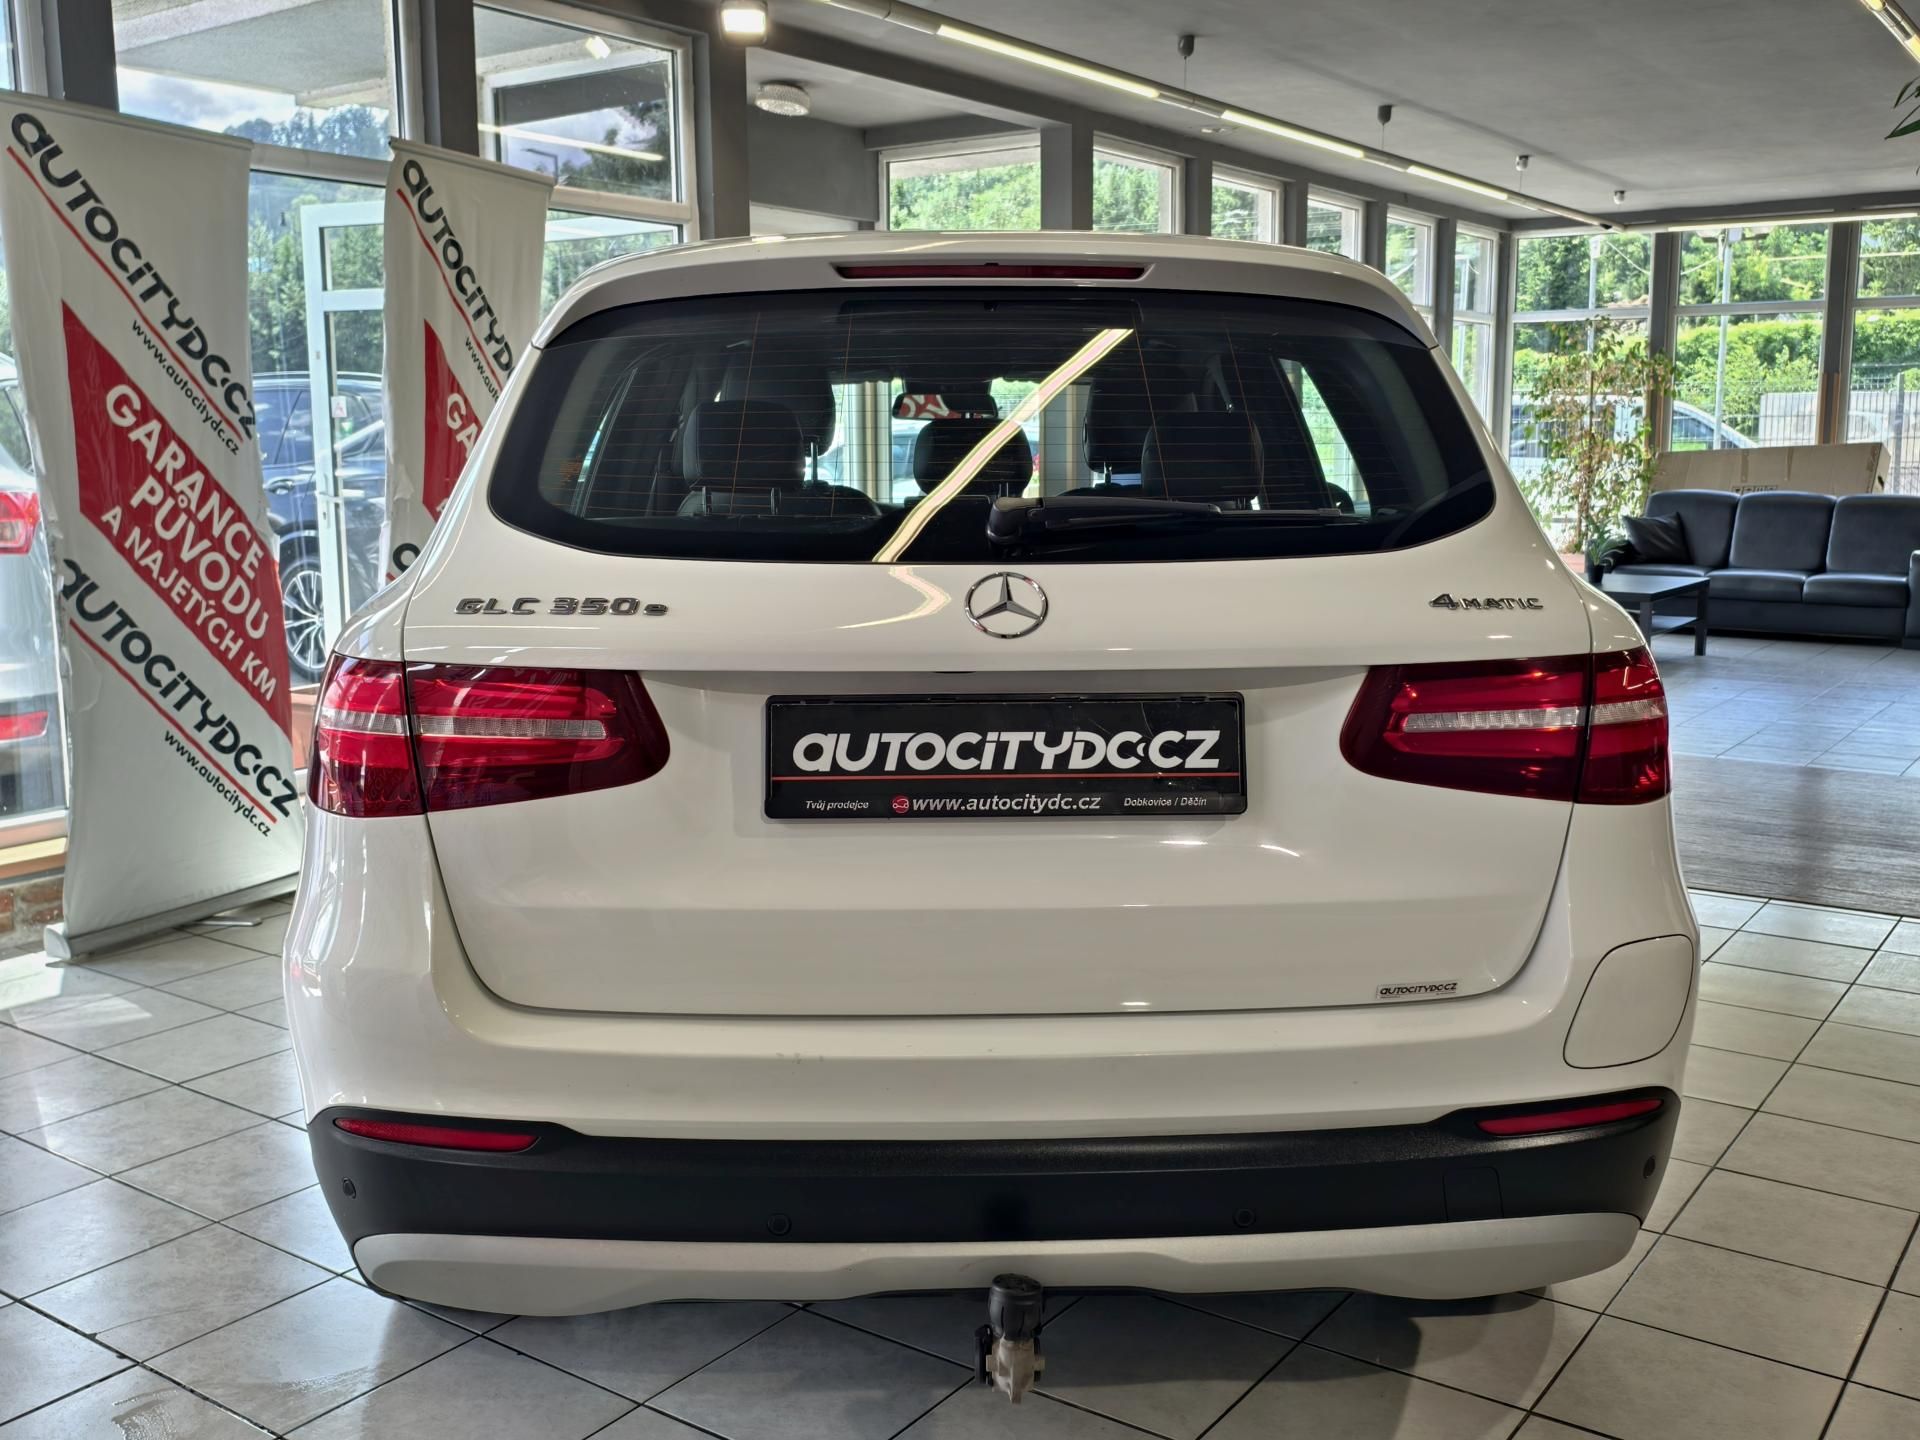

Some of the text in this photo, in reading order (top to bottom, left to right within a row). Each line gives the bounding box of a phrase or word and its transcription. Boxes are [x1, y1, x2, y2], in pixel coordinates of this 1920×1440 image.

[132, 319, 239, 456] www.autocitydc.cz
[106, 384, 264, 579] GARANCE
[101, 505, 277, 701] A NAJETÝCH KM
[130, 474, 269, 640] PŮVODU
[454, 597, 541, 615] GLC
[1428, 593, 1544, 610] 4MATIC
[164, 730, 271, 838] www.autocitydc.cz
[805, 799, 825, 811] Tvůj
[827, 800, 869, 811] prodejce
[912, 793, 1102, 814] www.autocitydc.cz
[1123, 797, 1172, 807] Dobkovice
[1180, 797, 1207, 807] Děčín
